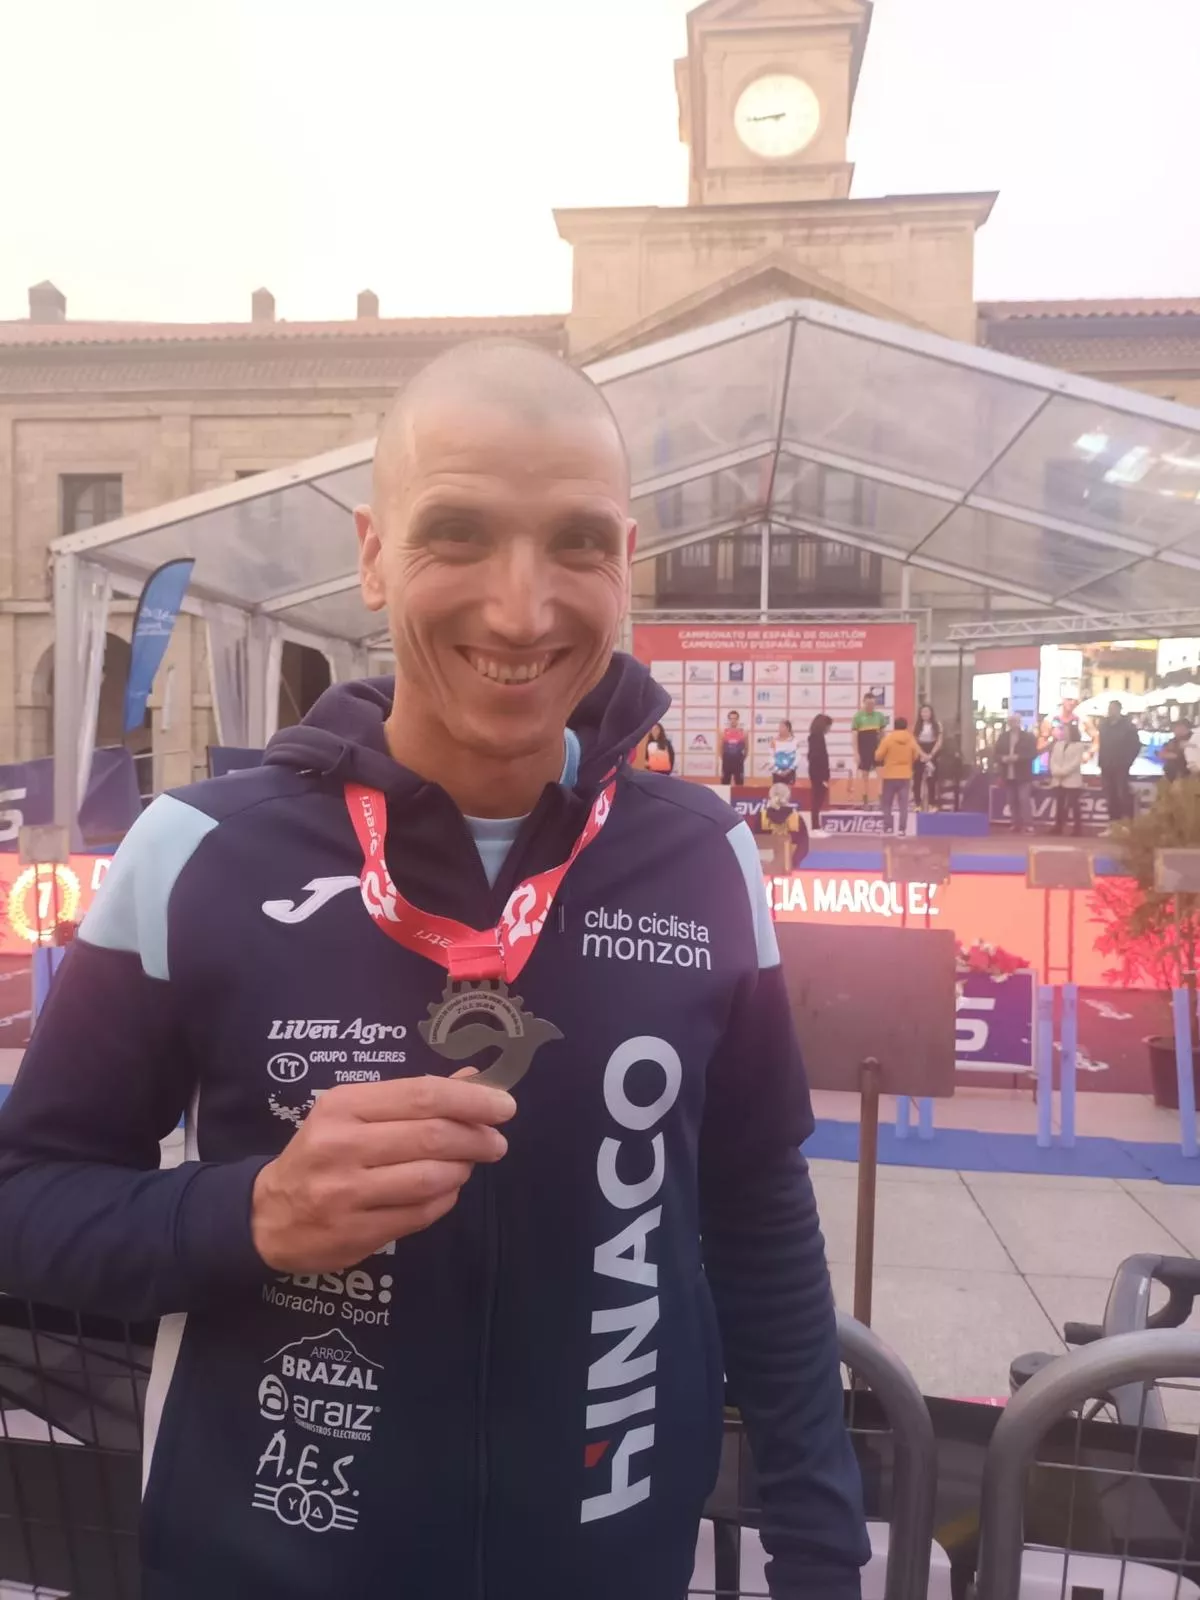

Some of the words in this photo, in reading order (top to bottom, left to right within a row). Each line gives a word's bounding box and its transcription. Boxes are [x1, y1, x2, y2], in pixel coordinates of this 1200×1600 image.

[678, 630, 745, 639] CAMPEONATO
[747, 630, 761, 639] DE
[762, 628, 801, 639] ESPAÑA
[803, 630, 817, 639] DE
[584, 906, 633, 931] club
[638, 912, 710, 944] ciclista
[582, 933, 712, 971] monzon
[338, 1017, 407, 1045] Agro
[309, 1051, 348, 1063] GRUPO
[352, 1051, 406, 1063] TALLERES
[334, 1070, 381, 1082] TAREMA
[580, 1035, 683, 1524] HINACO
[262, 1283, 336, 1316] Moracho
[340, 1301, 391, 1326] Sport
[281, 1354, 379, 1391] BRAZAL
[310, 1346, 353, 1363] ARROZ
[293, 1394, 374, 1431] araiz
[256, 1429, 360, 1497] A.E.S.
